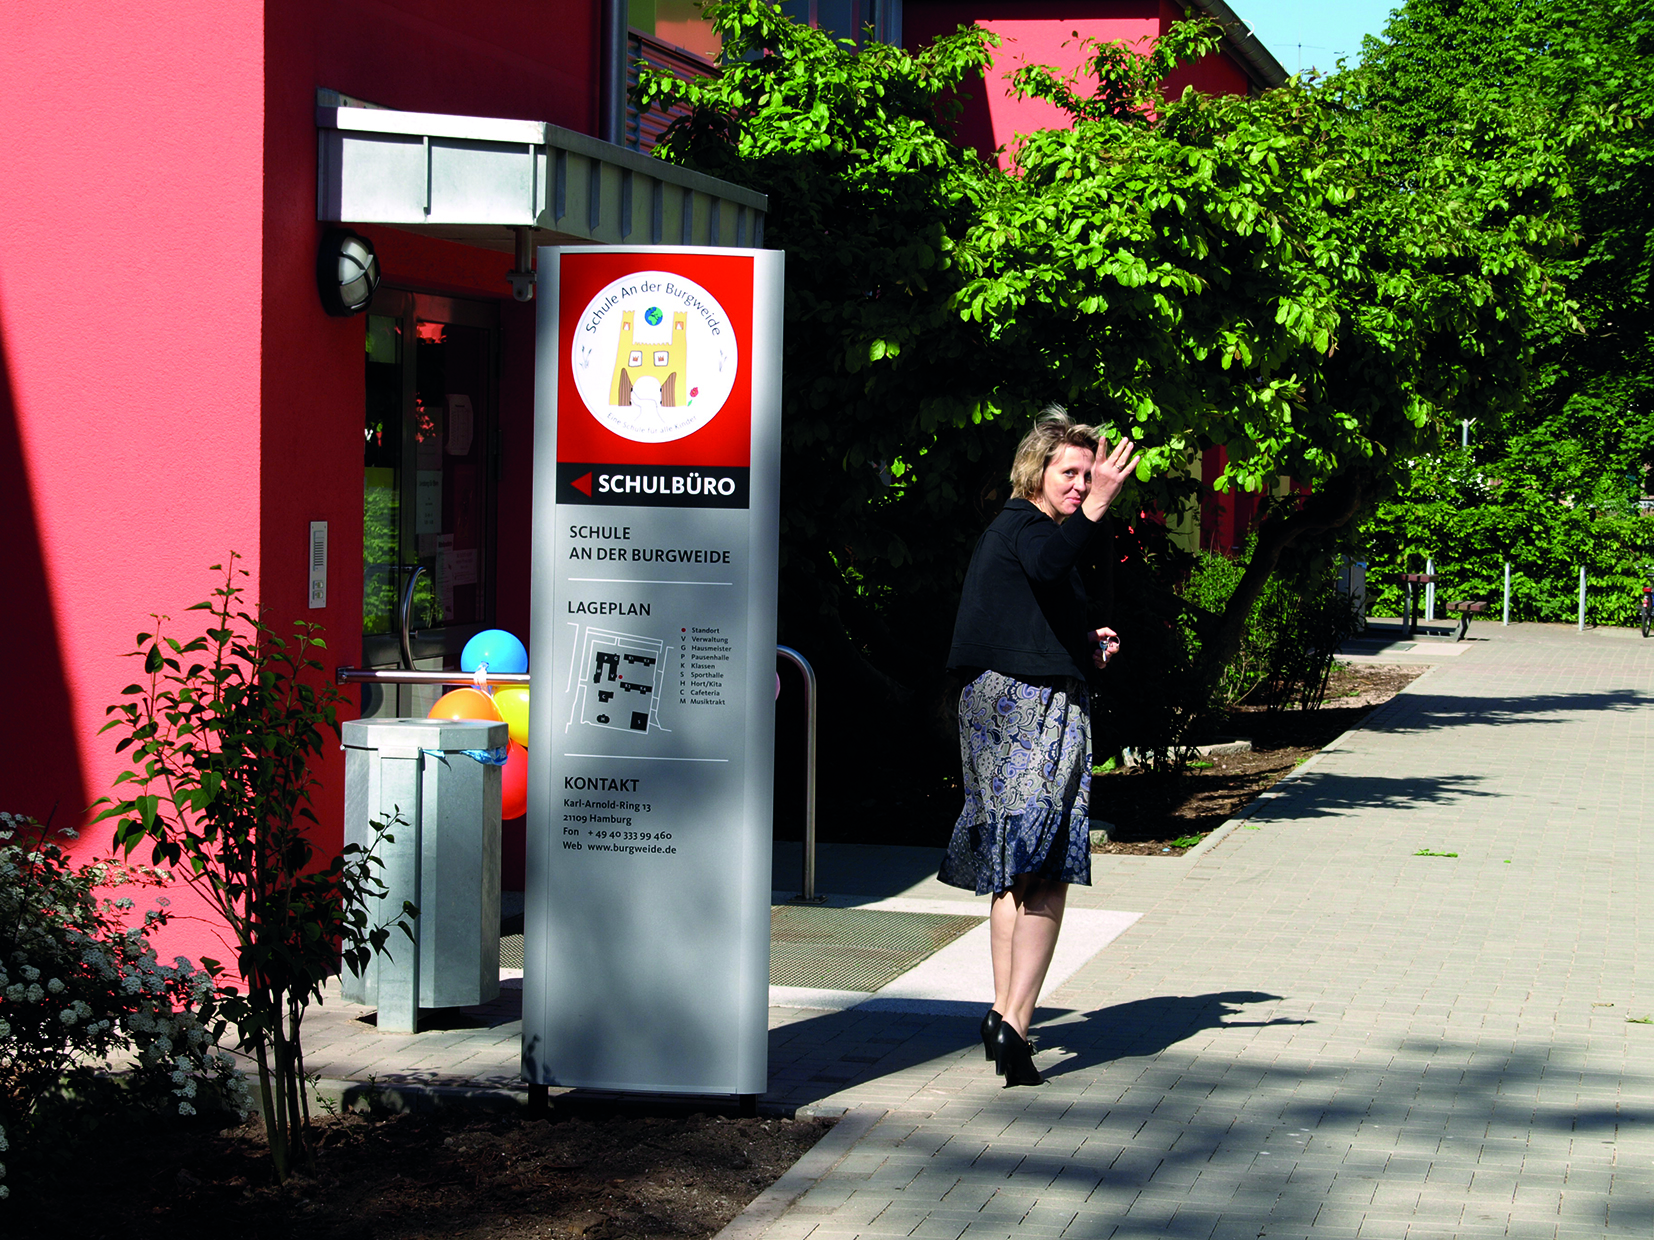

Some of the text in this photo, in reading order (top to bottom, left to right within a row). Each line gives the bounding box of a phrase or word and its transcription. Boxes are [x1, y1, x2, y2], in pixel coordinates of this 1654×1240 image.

[586, 281, 721, 336] Schule An der Burgweide
[607, 412, 621, 425] Eine
[623, 421, 645, 434] Schule
[674, 415, 697, 430] Kinder
[598, 472, 736, 496] SCHULBÜRO
[569, 525, 631, 540] SCHULE
[569, 547, 731, 564] AN DER BURGWEIDE
[567, 601, 651, 616] LAGEPLAN
[691, 636, 729, 645] Verwaltung
[690, 672, 724, 680] Sporthalle
[564, 776, 640, 792] KONTAKT
[563, 799, 652, 813] Karl-Arnold-Ring 13
[563, 814, 632, 826] 21109 Hamburg
[563, 827, 579, 836] Fon
[595, 830, 607, 839] 49
[609, 831, 622, 839] 40
[623, 831, 638, 840] 333
[640, 832, 652, 841] 99
[653, 831, 672, 841] 460
[563, 841, 677, 855] Web www.burgweide.de
